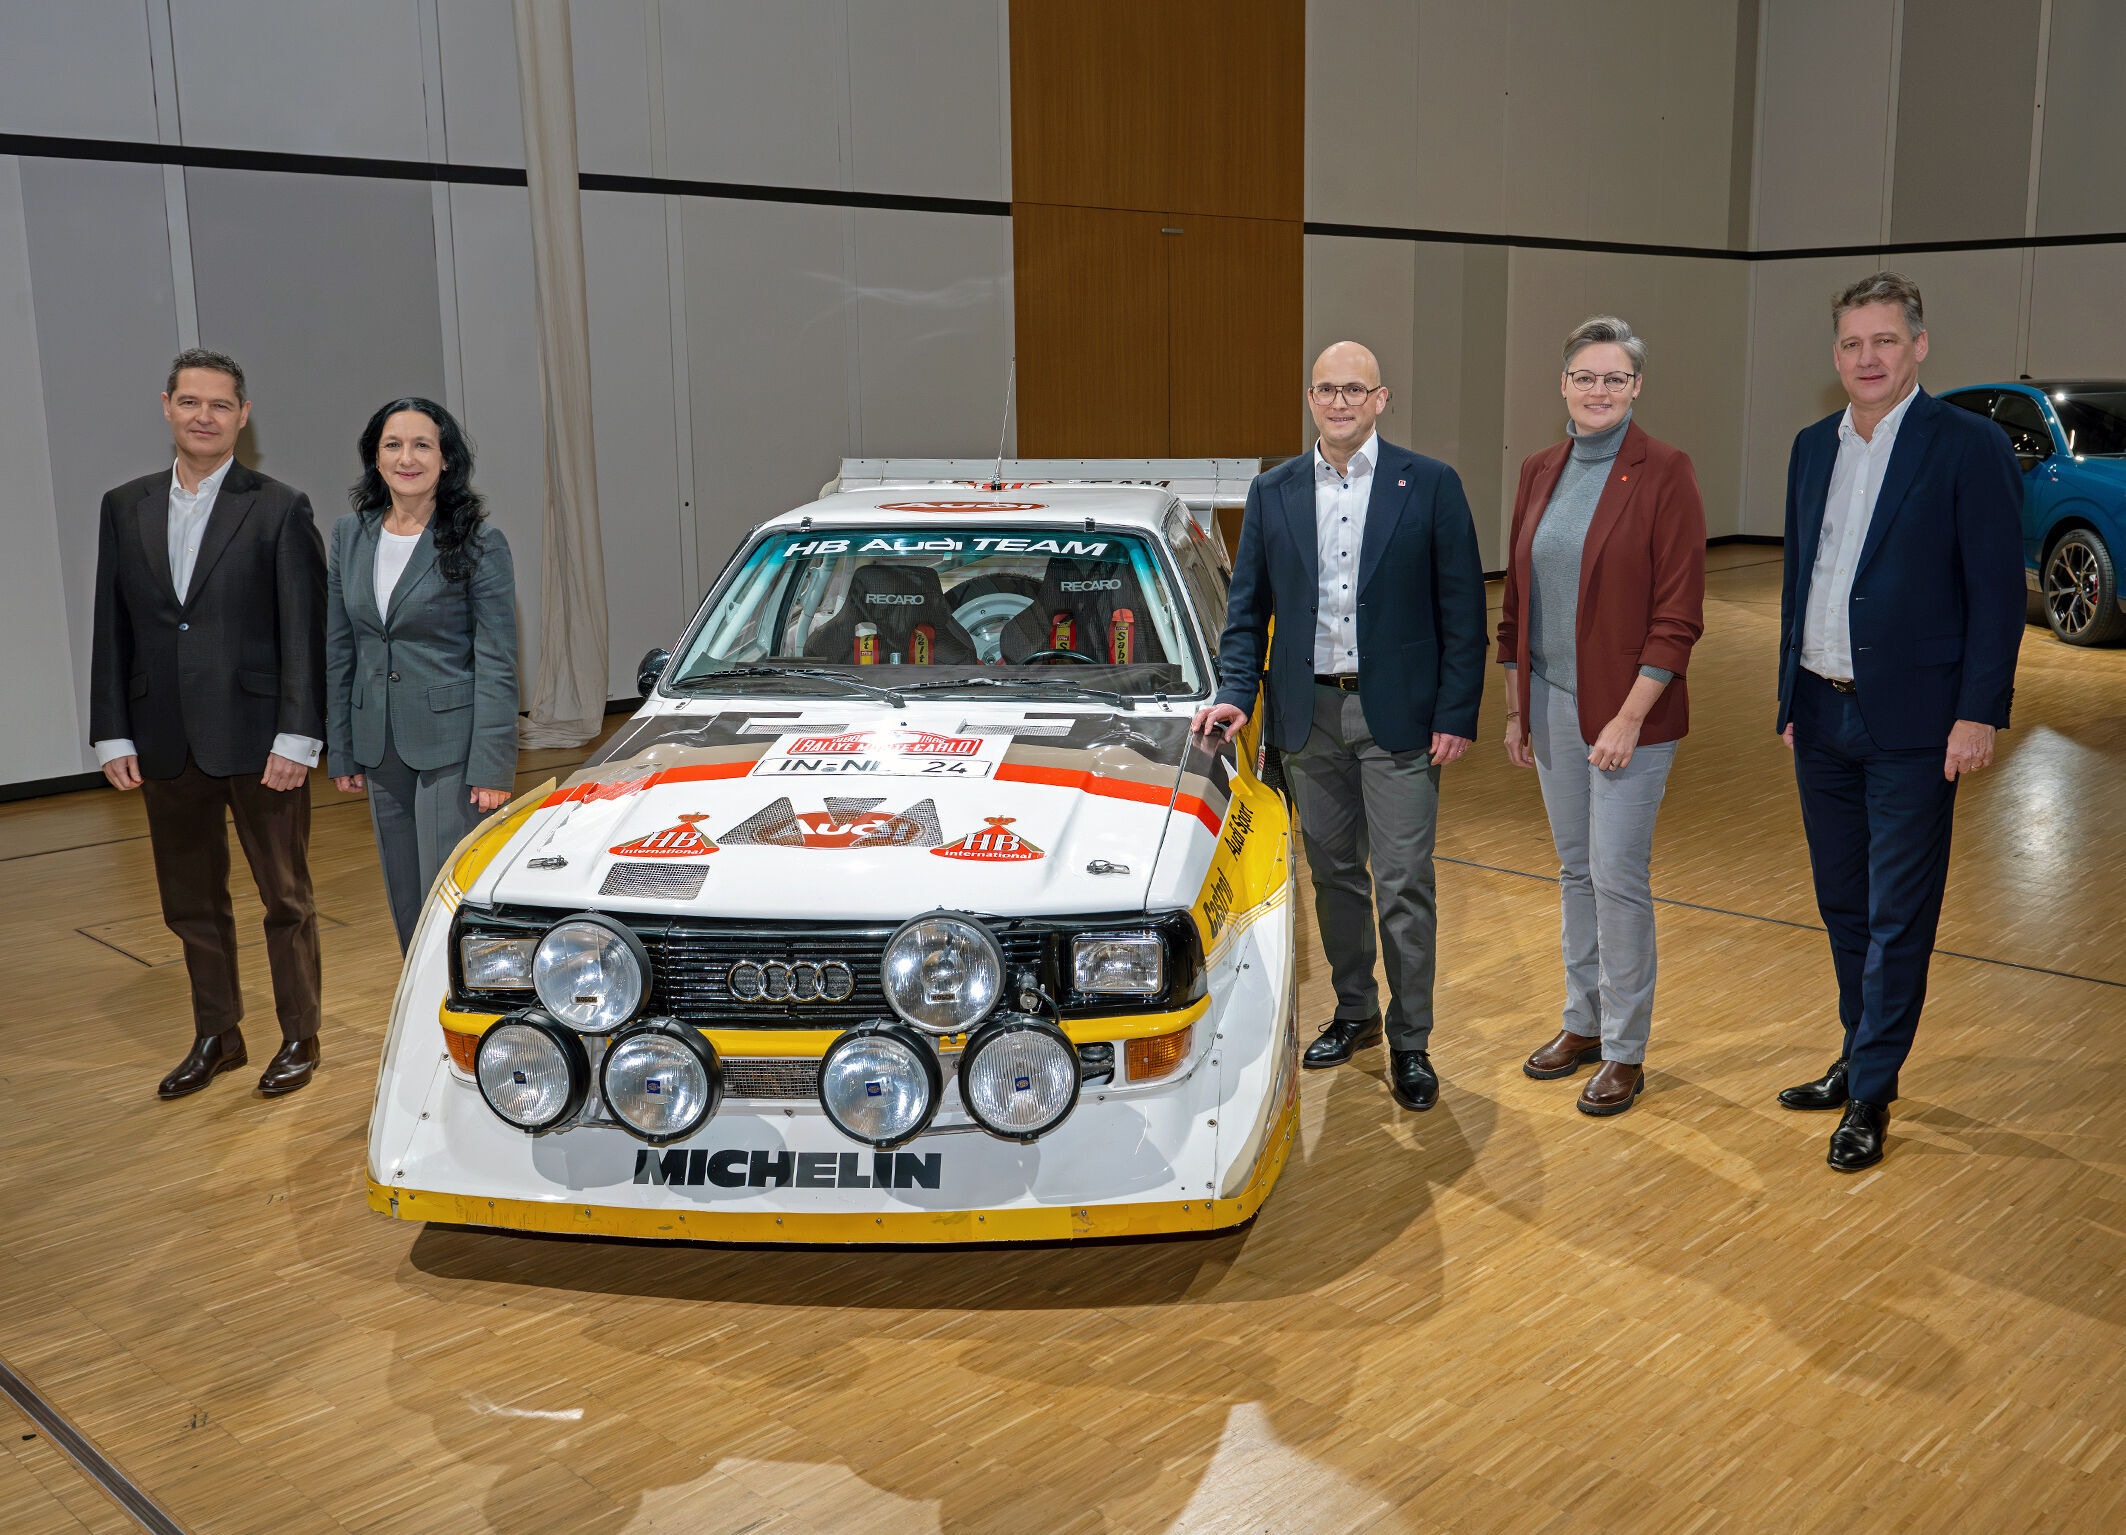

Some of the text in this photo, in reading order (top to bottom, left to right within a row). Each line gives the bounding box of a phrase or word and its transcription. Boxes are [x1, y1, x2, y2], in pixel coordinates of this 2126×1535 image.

[784, 539, 850, 557] HB
[973, 538, 1108, 556] TEAM
[1061, 579, 1121, 592] RECARO
[865, 593, 924, 605] RECARO
[799, 739, 971, 753] RALLYE MTE-CARLO
[921, 761, 967, 774] 24
[1224, 799, 1254, 862] Audi Sport
[639, 831, 703, 848] HB
[962, 833, 1021, 851] HB
[1203, 867, 1234, 939] Castrol
[633, 1149, 942, 1189] MICHELIN
